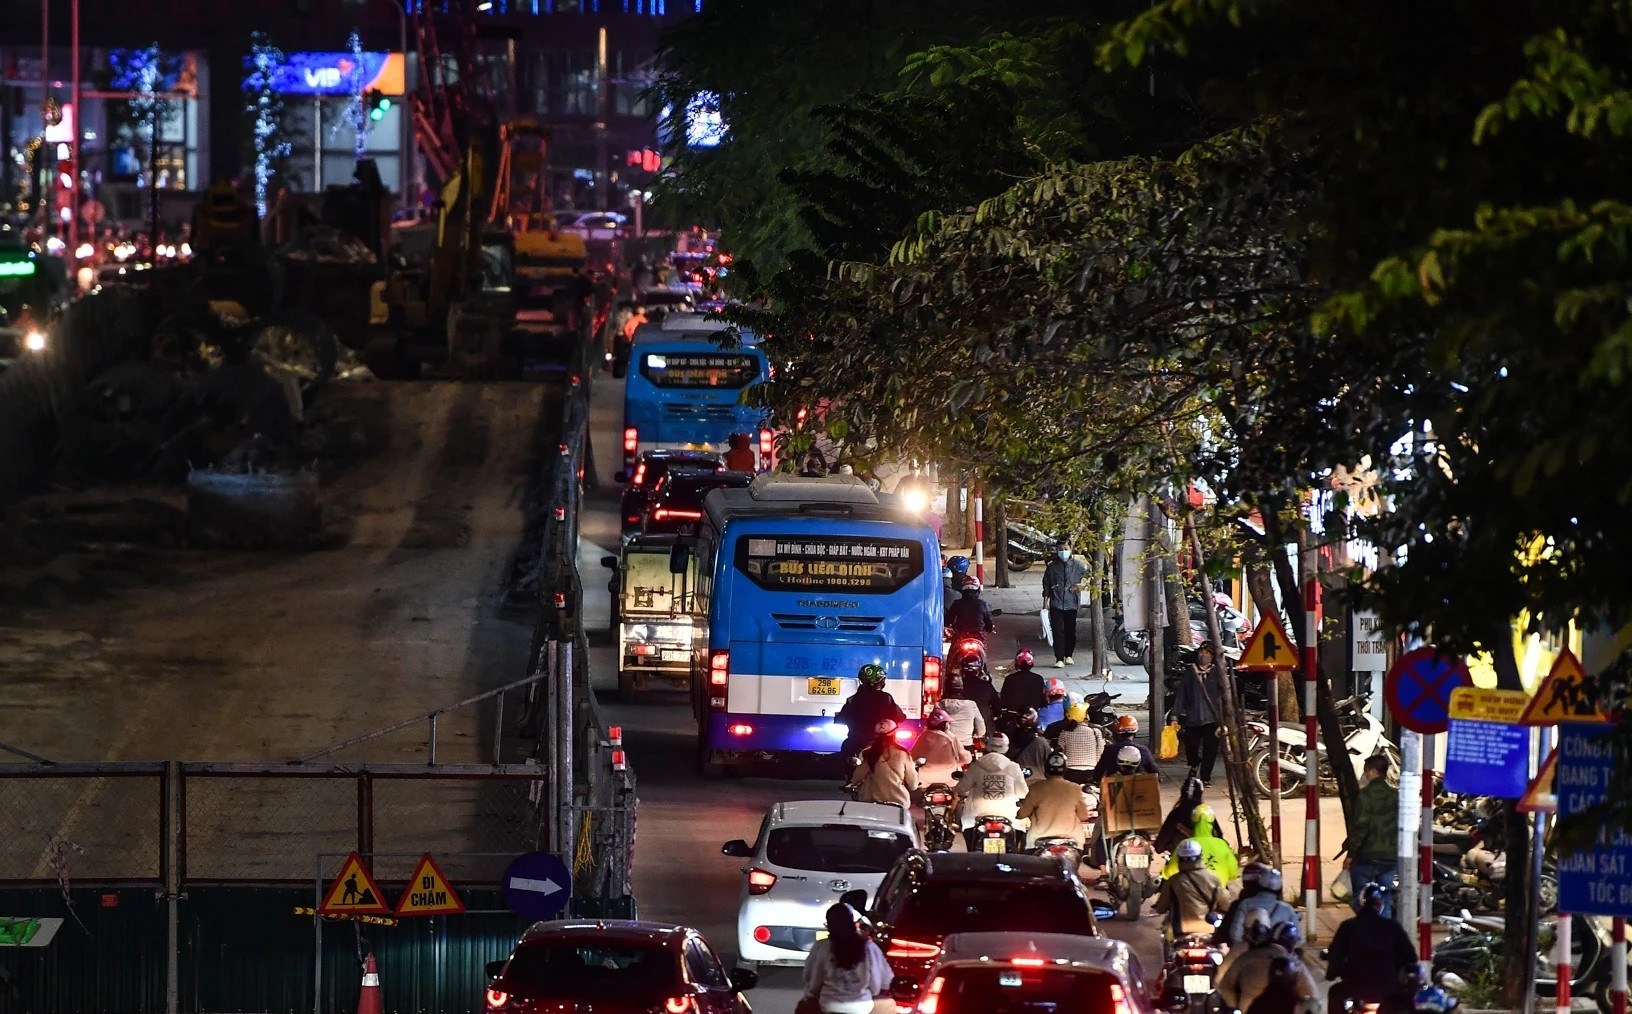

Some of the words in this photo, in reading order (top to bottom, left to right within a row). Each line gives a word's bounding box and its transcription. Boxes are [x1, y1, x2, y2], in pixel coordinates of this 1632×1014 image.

[304, 68, 341, 87] VIB
[780, 562, 804, 574] BUS
[808, 561, 835, 575] LIÊN
[787, 576, 824, 585] Hotline
[422, 876, 435, 890] ĐI
[411, 890, 446, 907] CHẬM
